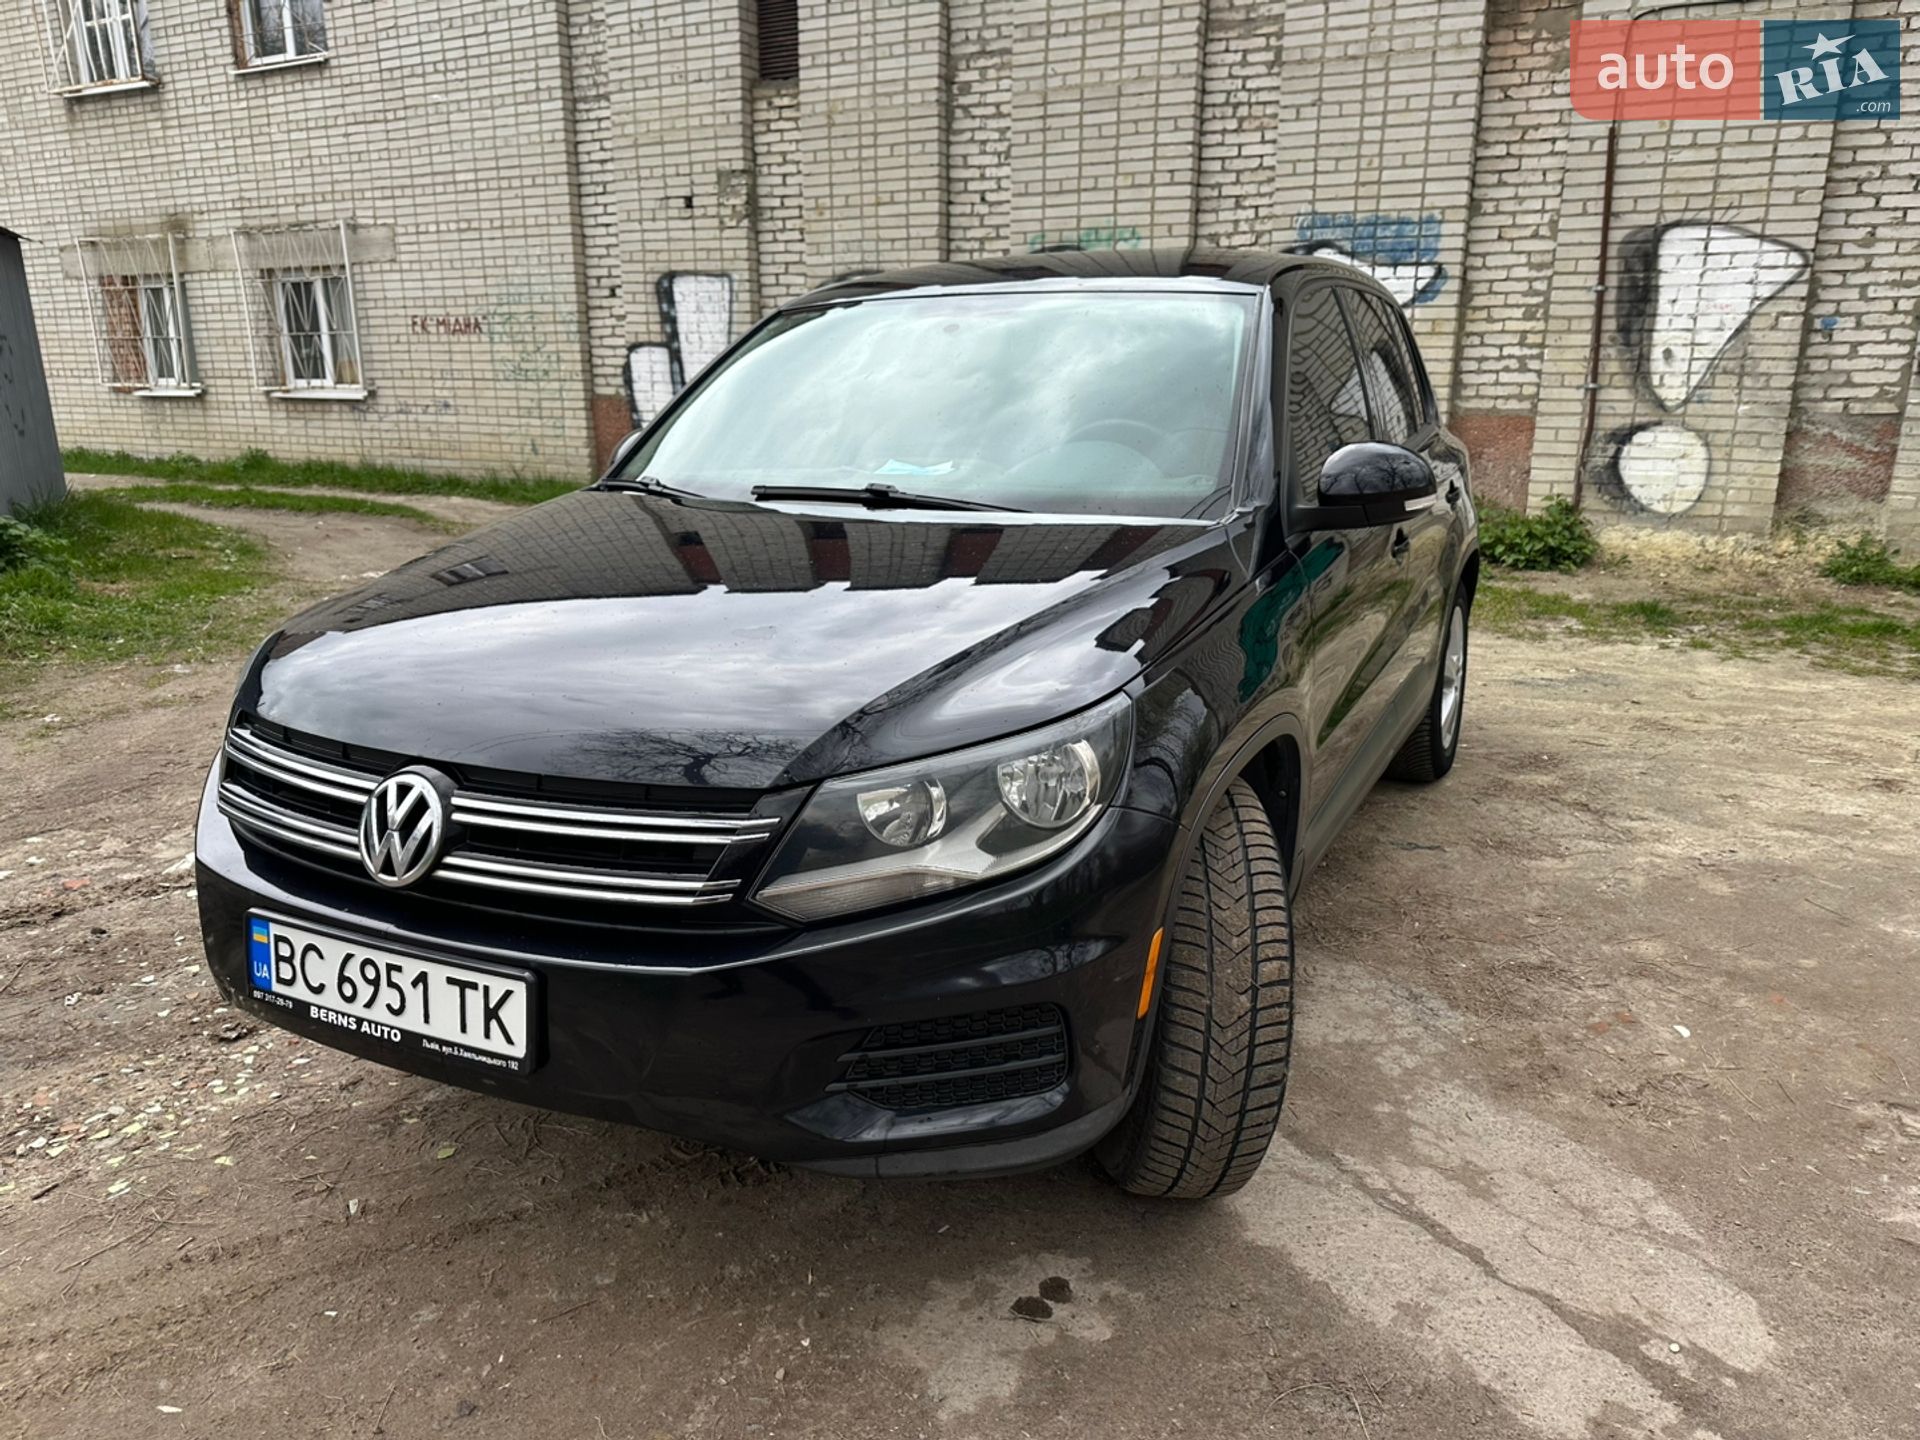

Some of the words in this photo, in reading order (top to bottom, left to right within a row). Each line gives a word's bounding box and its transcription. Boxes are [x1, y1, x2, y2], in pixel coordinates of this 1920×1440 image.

[253, 962, 271, 980] UA
[273, 933, 326, 995] BC
[337, 952, 431, 1024] 6951
[446, 976, 515, 1046] TK
[310, 1005, 357, 1030] BERNS
[361, 1020, 401, 1043] AUTO
